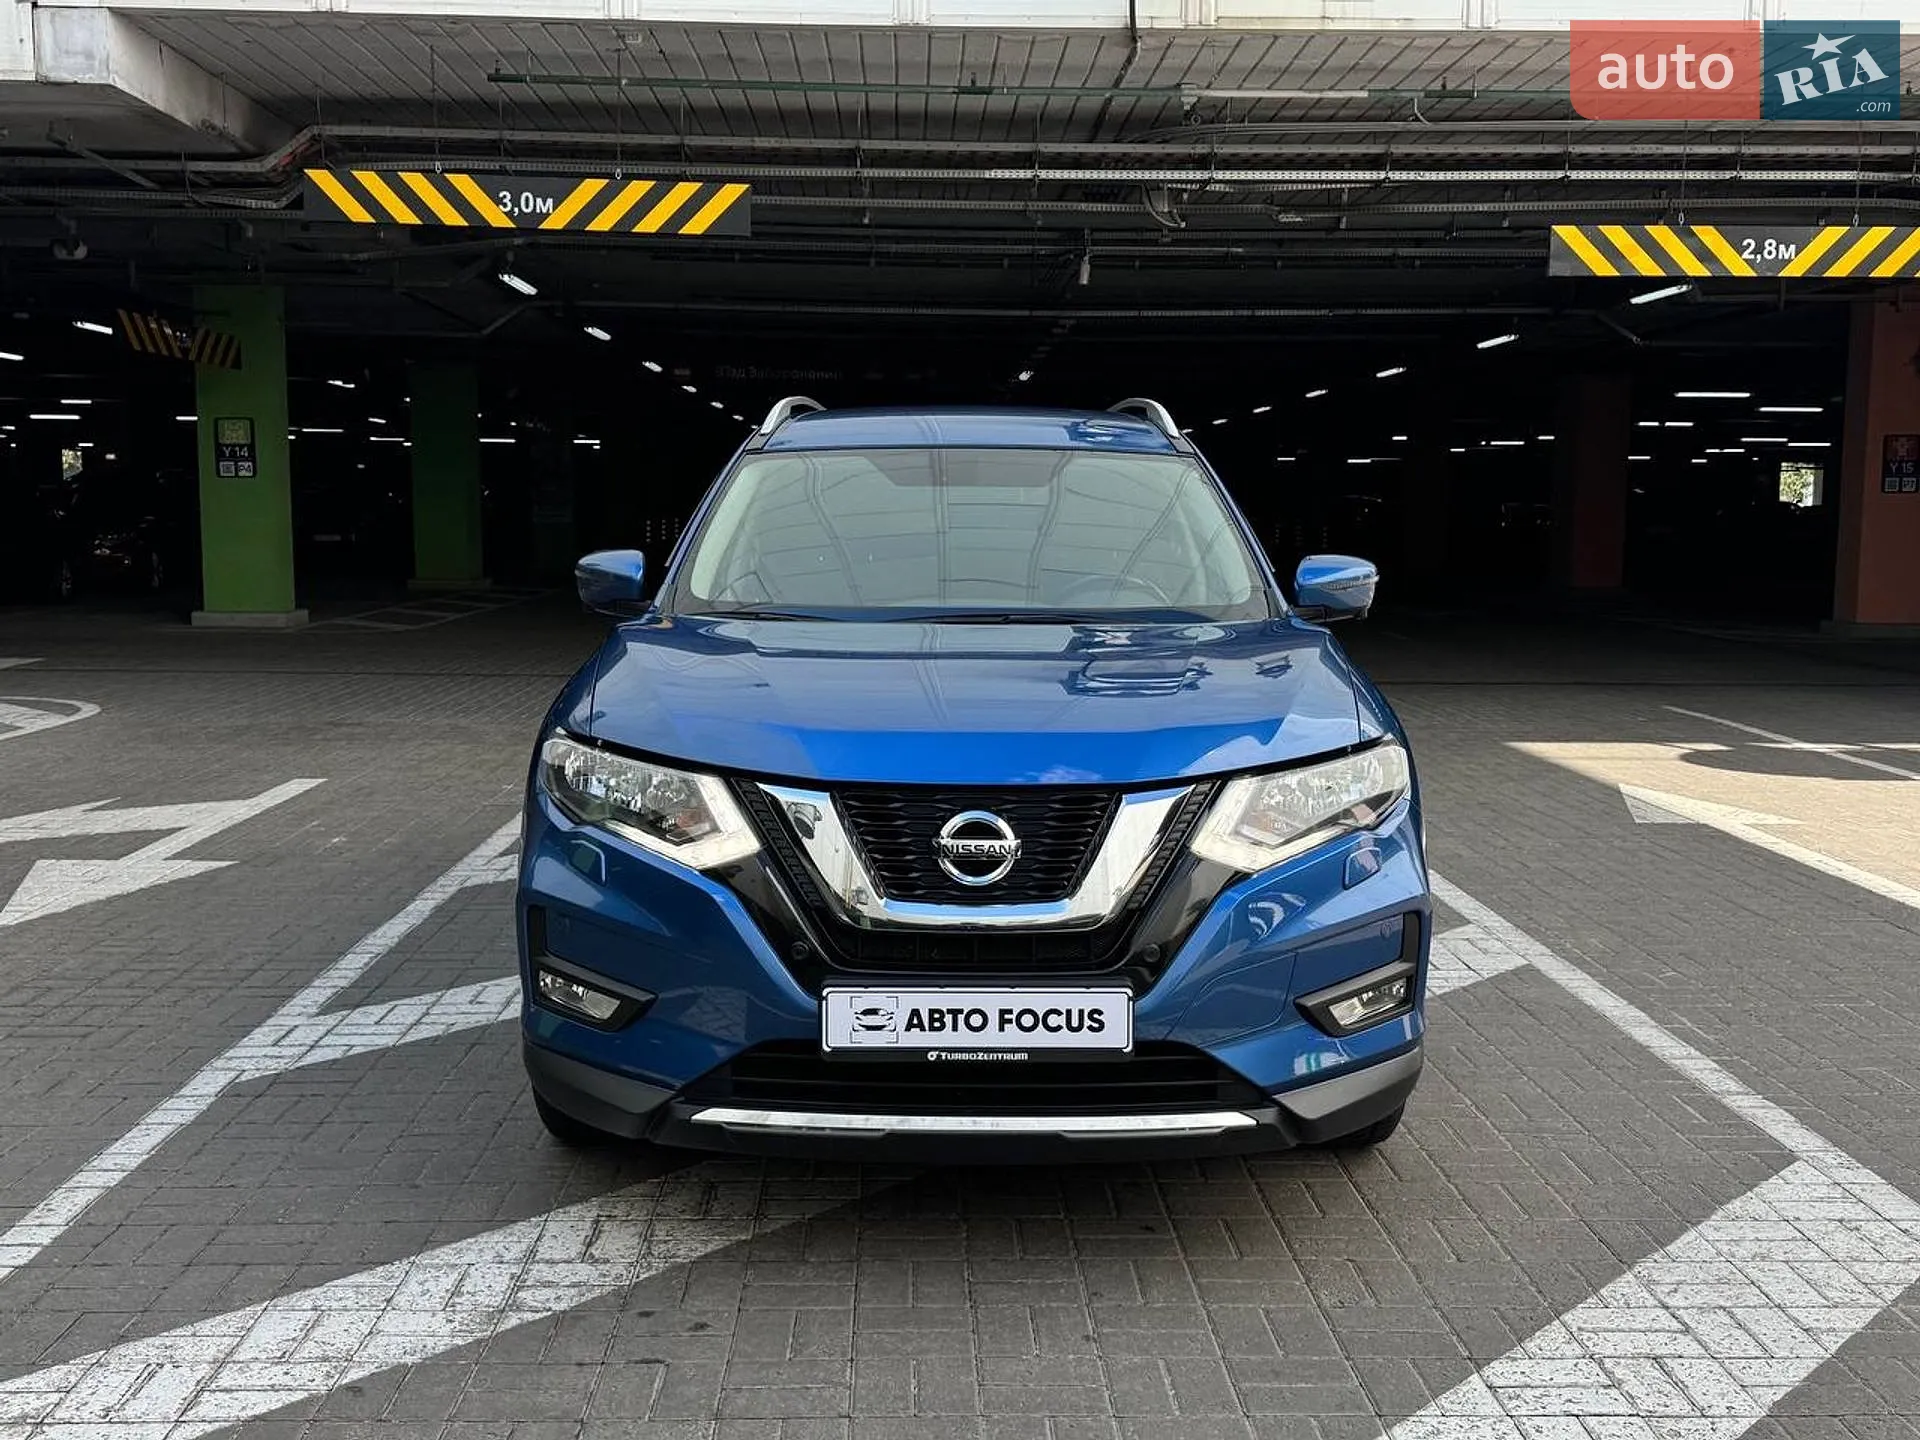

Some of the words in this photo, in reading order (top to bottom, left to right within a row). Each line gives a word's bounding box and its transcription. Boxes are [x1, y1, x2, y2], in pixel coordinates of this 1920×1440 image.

[498, 190, 554, 216] 3,0м
[1741, 239, 1796, 264] 2,8м
[235, 446, 249, 457] 14
[941, 844, 1011, 856] NISSAN
[904, 1008, 989, 1033] АВТО
[998, 1008, 1105, 1033] FOCUS
